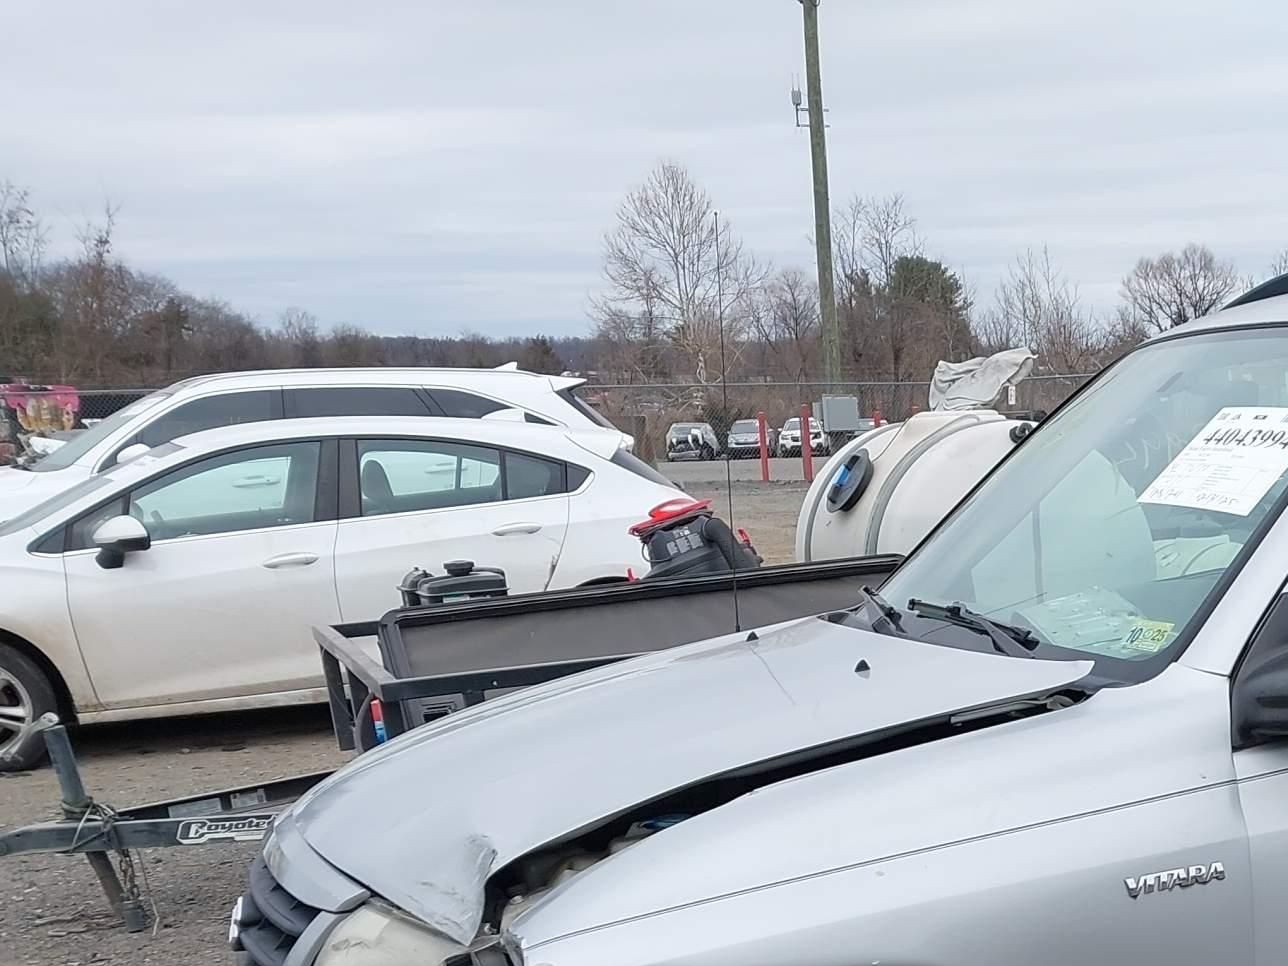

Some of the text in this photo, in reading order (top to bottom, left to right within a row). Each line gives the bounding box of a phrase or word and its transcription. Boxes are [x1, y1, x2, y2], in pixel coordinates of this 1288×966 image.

[1126, 626, 1168, 643] 10 25
[1124, 861, 1226, 900] VITARA
